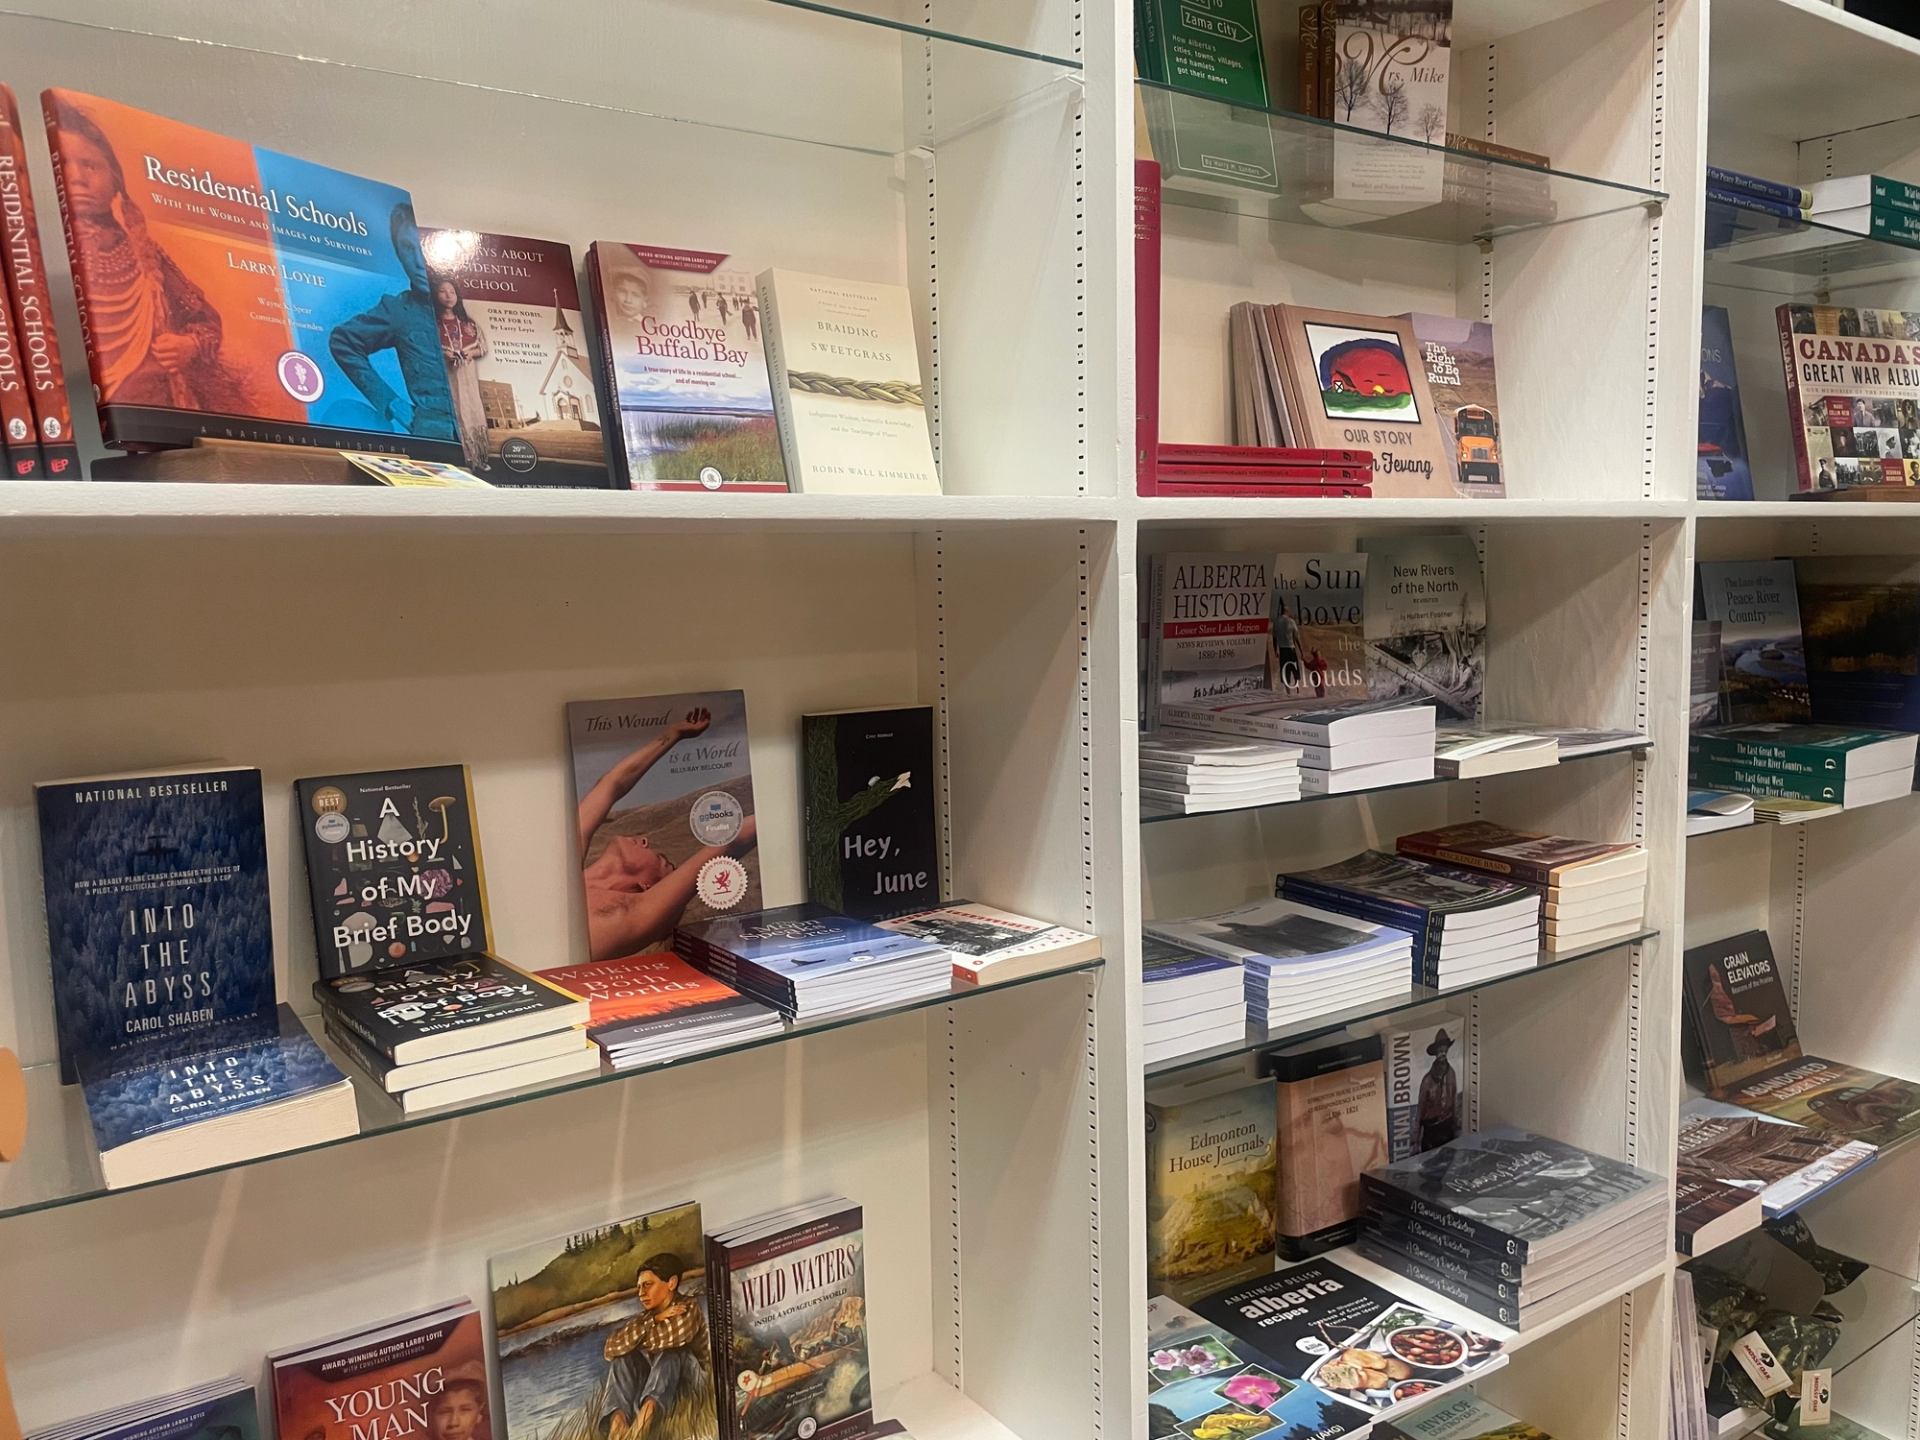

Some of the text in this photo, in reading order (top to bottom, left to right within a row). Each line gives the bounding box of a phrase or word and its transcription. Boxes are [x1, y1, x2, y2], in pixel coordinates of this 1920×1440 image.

[1186, 12, 1238, 39] Zama City
[1175, 56, 1215, 71] and hamlets
[1217, 56, 1243, 69] villages,
[1177, 66, 1228, 84] got their names
[1410, 67, 1445, 84] Mike
[144, 155, 368, 237] Residential Schools
[501, 249, 545, 263] ABOUT
[0, 155, 54, 391] RESIDENTIAL SCHOOLS
[464, 279, 518, 293] SCHOOL
[636, 315, 749, 368] Goodbye Buffalo Bay
[817, 321, 879, 339] BRAIDING
[812, 342, 892, 362] SWEETGRASS
[1425, 342, 1447, 354] The
[1426, 351, 1456, 367] Right
[1800, 338, 1920, 366] CANADA'S
[696, 370, 721, 379] residential
[1428, 372, 1461, 386] Rural
[1433, 363, 1459, 376] to Be
[1803, 362, 1881, 385] GREAT WAR
[691, 379, 709, 387] moving
[226, 428, 318, 448] NATIONAL
[1343, 429, 1413, 446] OUR STORY
[812, 465, 928, 480] ROBIN WALL KIMMERER
[1380, 452, 1433, 479] Fevang
[1172, 563, 1266, 590] ALBERTA
[1274, 559, 1360, 590] the Sun
[1393, 564, 1455, 578] New Rivers
[1391, 580, 1459, 594] of the North
[1727, 590, 1780, 605] Peace River
[1173, 592, 1266, 618] HISTORY
[1276, 594, 1361, 626] Above
[1728, 609, 1767, 625] Country
[1175, 622, 1260, 635] Lesser Slave Lake Region
[1338, 636, 1361, 651] the
[1281, 659, 1363, 689] Clouds
[585, 708, 672, 732] This Wound
[669, 741, 740, 764] is a World
[1747, 744, 1786, 758] Last Great West
[1767, 758, 1781, 769] River
[1782, 760, 1802, 774] Country
[75, 780, 229, 804] NATIONAL BESTSELLER
[360, 785, 384, 793] National
[1771, 775, 1784, 787] West
[318, 798, 340, 807] BEST
[379, 797, 400, 819] A
[346, 838, 441, 863] History
[844, 835, 900, 860] Hey,
[75, 866, 231, 889] HOW DEADLY PLANE CRASH CHANGED THE LIVES
[1483, 860, 1507, 873] BASIN
[167, 878, 197, 888] CRIMINAL
[361, 874, 437, 902] of My
[873, 870, 929, 895] June
[130, 903, 195, 936] INTO
[333, 909, 472, 949] Brief Body
[785, 926, 844, 940] Cree
[141, 939, 190, 970] THE
[1723, 952, 1749, 969] GRAIN
[374, 970, 474, 995] History
[547, 959, 670, 983] Walking
[581, 974, 667, 992] Both
[1727, 960, 1770, 984] ELEVATORS
[125, 971, 212, 1008] ABYSS
[377, 983, 530, 1020] Brief Body
[401, 981, 482, 1002] of My
[584, 980, 703, 1003] Worlds
[126, 1008, 215, 1033] CAROL SHABEN
[420, 1002, 544, 1033] Billy-Ray Belcourt
[169, 1057, 239, 1080] INTO
[184, 1070, 239, 1088] THE
[1393, 1033, 1411, 1105] BROWN
[1741, 1062, 1828, 1098] ABANDONED
[169, 1075, 265, 1105] ABYSS
[171, 1087, 272, 1113] CAROL SHABEN
[1189, 1121, 1256, 1151] Edmonton
[1169, 1136, 1265, 1173] House Journals
[741, 1244, 857, 1315] WILD WATERS
[1224, 1269, 1322, 1306] AMAZINGLY DELISH
[754, 1314, 777, 1327] INSIDE
[823, 1287, 847, 1302] WORLD
[1239, 1275, 1345, 1321] alberta
[1256, 1306, 1310, 1330] recipes
[321, 1330, 443, 1371] AWARD-WINNING AUTHOR LARRY LOYIE
[1743, 1344, 1771, 1381] MOSSY OAK
[325, 1366, 446, 1424] YOUNG
[172, 1417, 189, 1427] LARRY
[350, 1402, 429, 1440] MAN
[1415, 1400, 1471, 1433] RIVER OF
